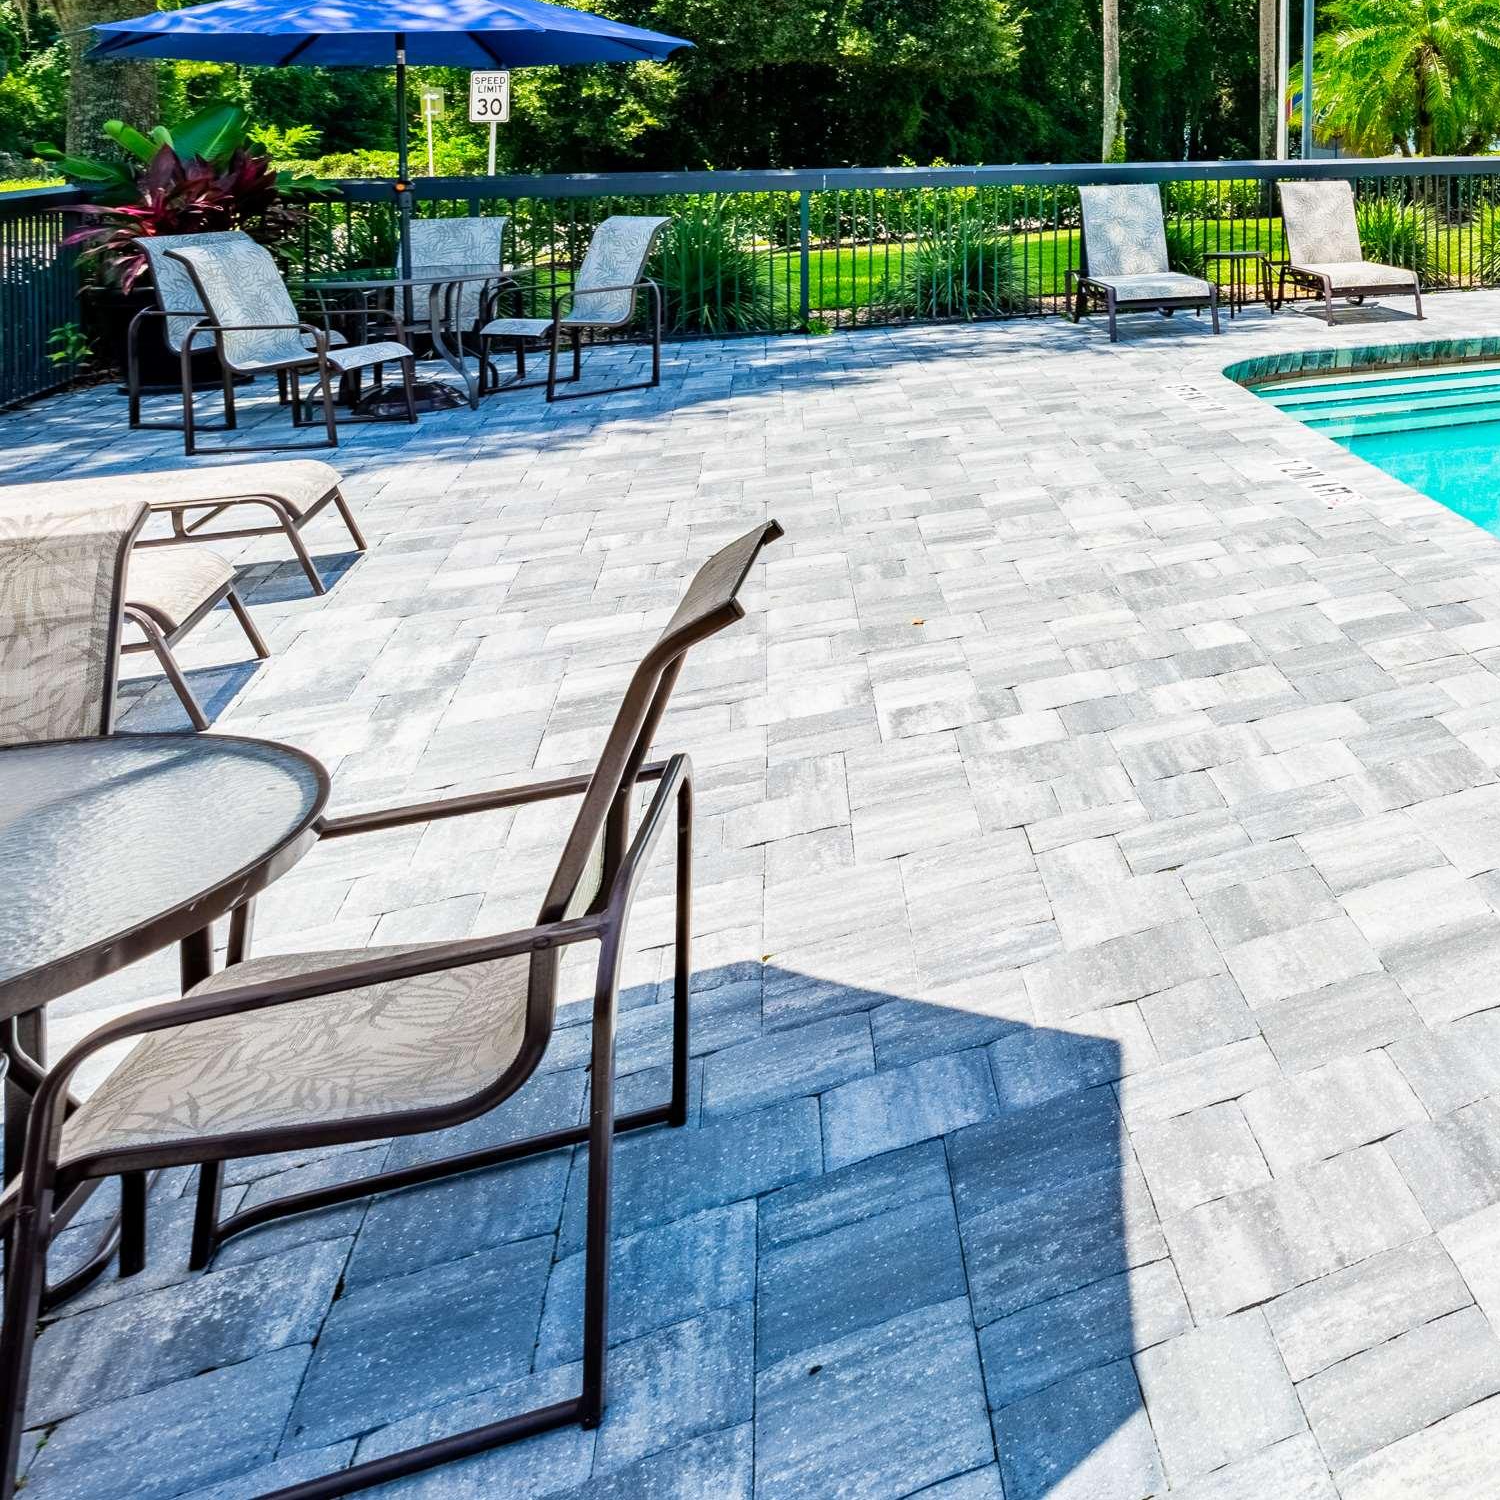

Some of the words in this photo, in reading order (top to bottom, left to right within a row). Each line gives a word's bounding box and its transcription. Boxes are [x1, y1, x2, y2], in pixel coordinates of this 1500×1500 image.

[474, 76, 506, 85] SPEED
[477, 85, 503, 94] LIMIT
[476, 98, 503, 116] 30
